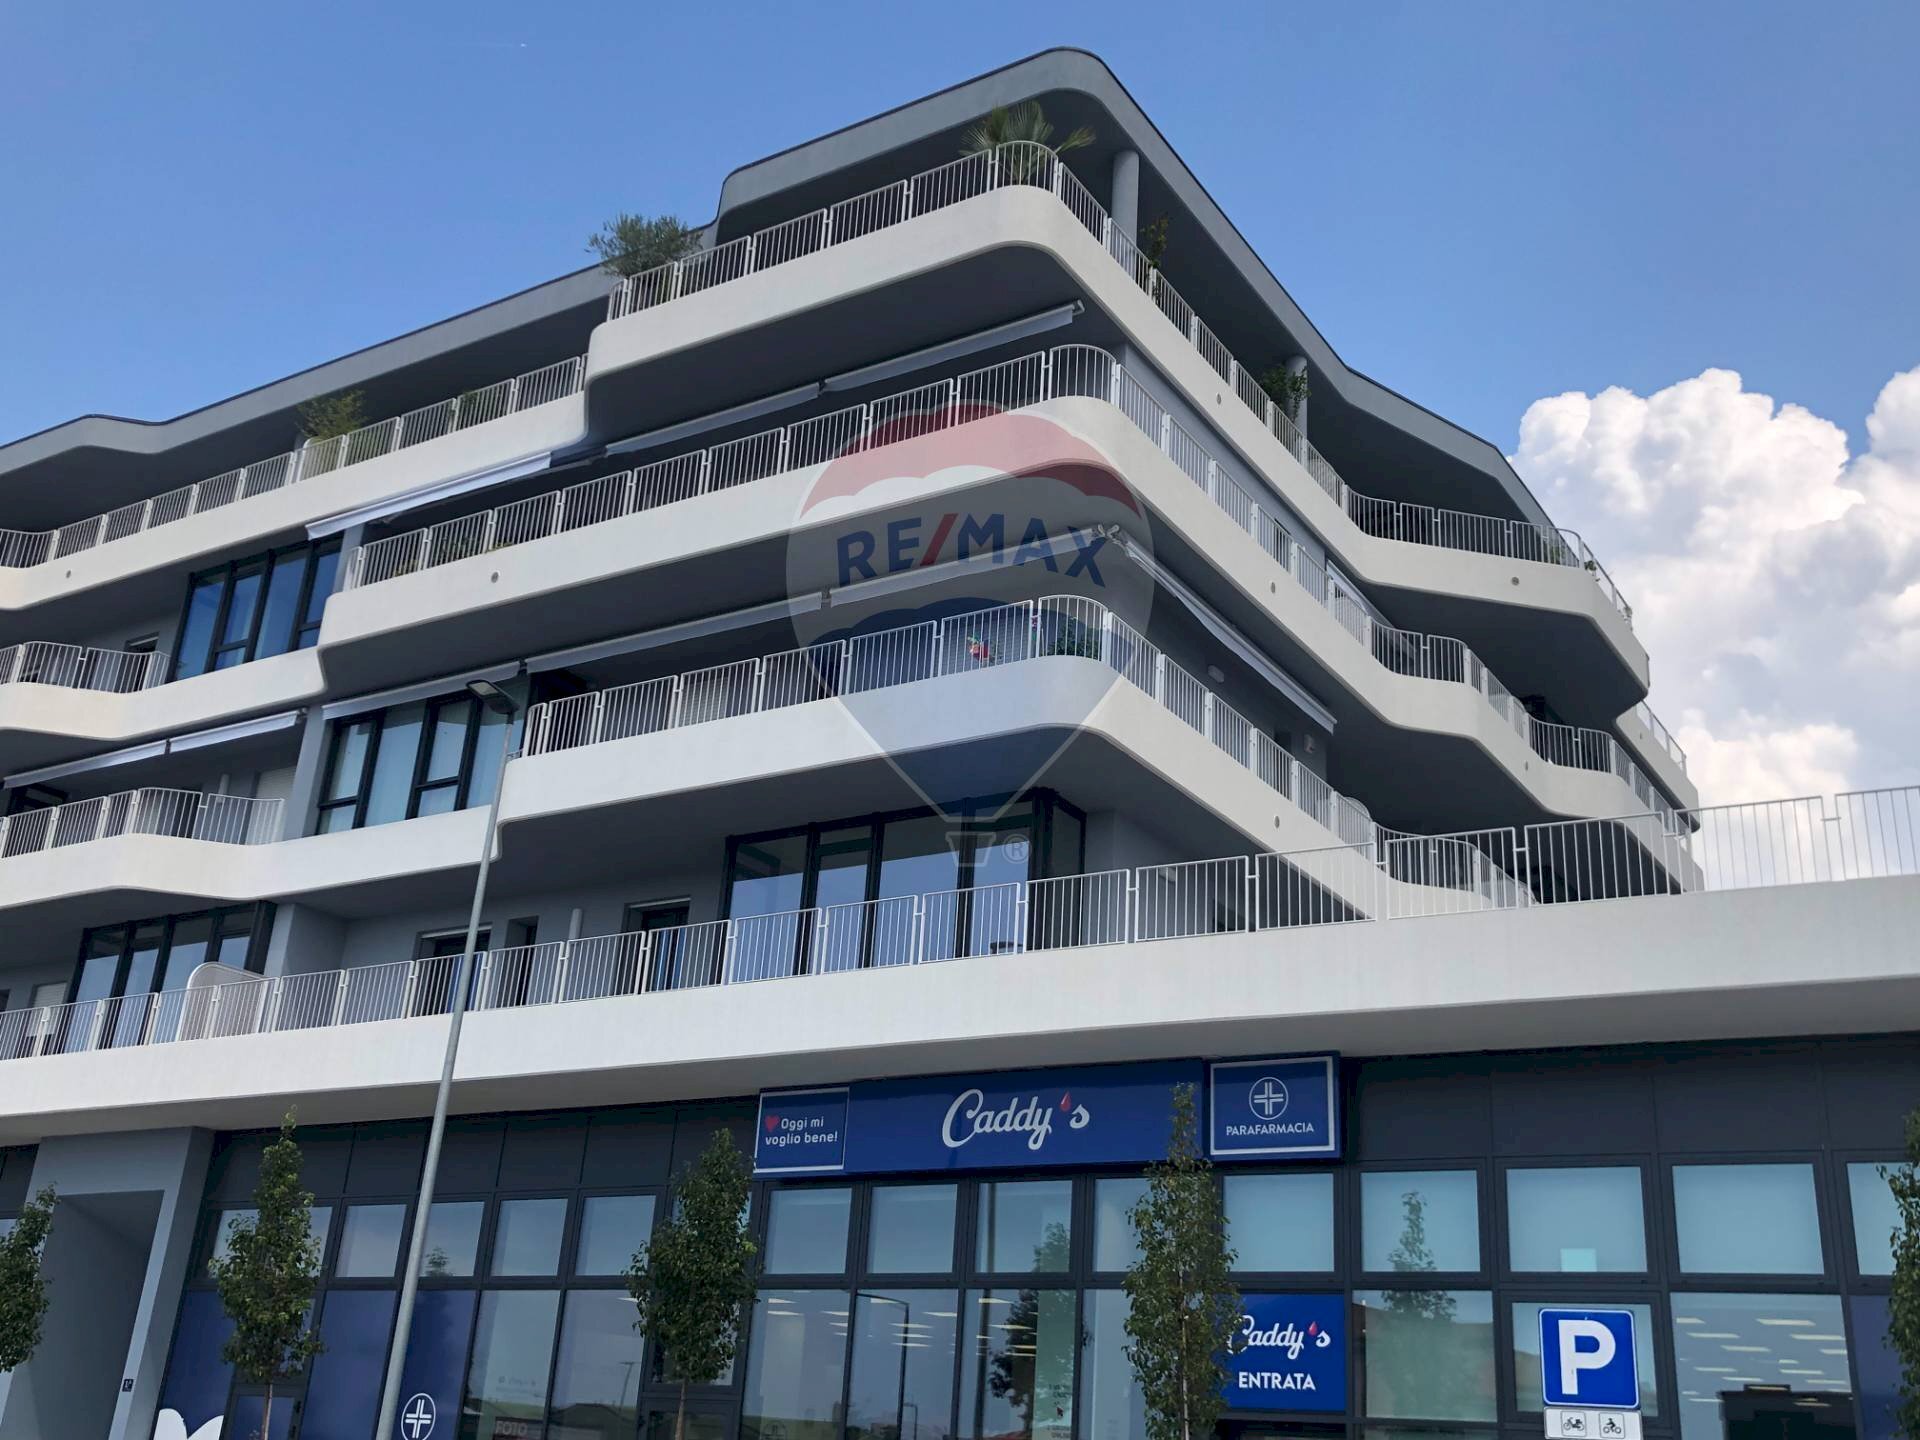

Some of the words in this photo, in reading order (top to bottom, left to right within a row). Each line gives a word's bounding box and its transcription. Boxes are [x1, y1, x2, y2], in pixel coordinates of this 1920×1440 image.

[781, 1117, 808, 1131] Oggi
[811, 1116, 824, 1127] mi
[942, 1088, 1090, 1150] Caddy's
[1226, 1122, 1315, 1136] PARAFARMACIA
[765, 1133, 801, 1147] voglio
[804, 1130, 838, 1143] bene!
[1558, 1319, 1616, 1395] P
[1238, 1371, 1316, 1390] ENTRATA
[495, 1420, 528, 1436] FOTO
